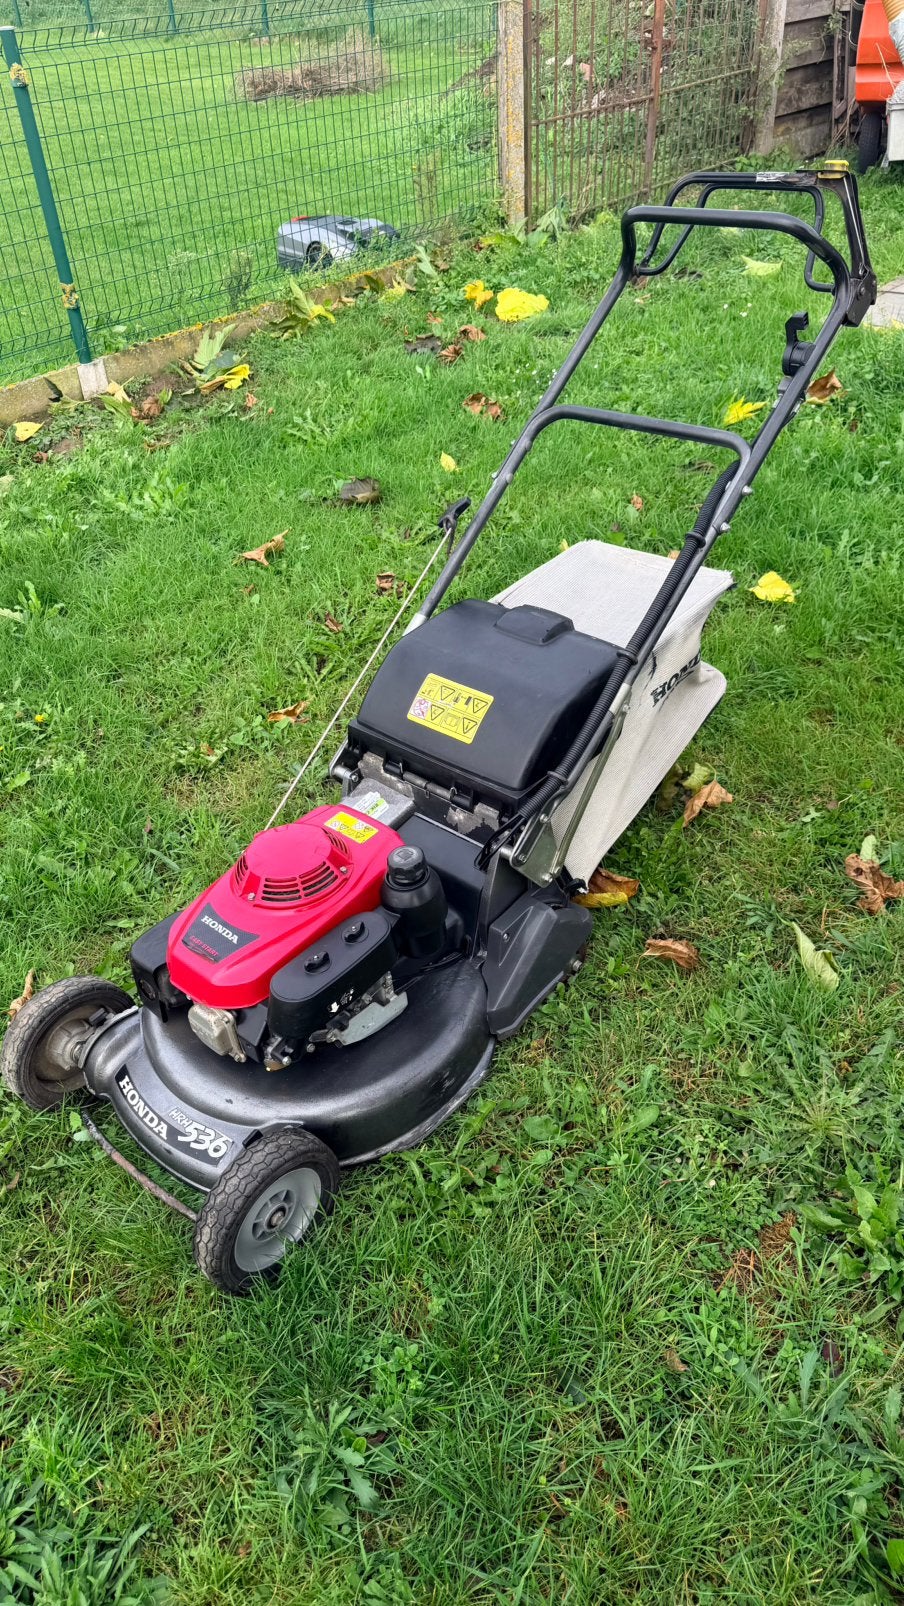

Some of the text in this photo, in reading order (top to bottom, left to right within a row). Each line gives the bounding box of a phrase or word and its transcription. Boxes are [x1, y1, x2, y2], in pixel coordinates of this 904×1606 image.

[201, 915, 239, 944] HONDA
[202, 943, 219, 957] START
[119, 1075, 168, 1140] HONDA
[168, 1108, 227, 1158] HRH 536
